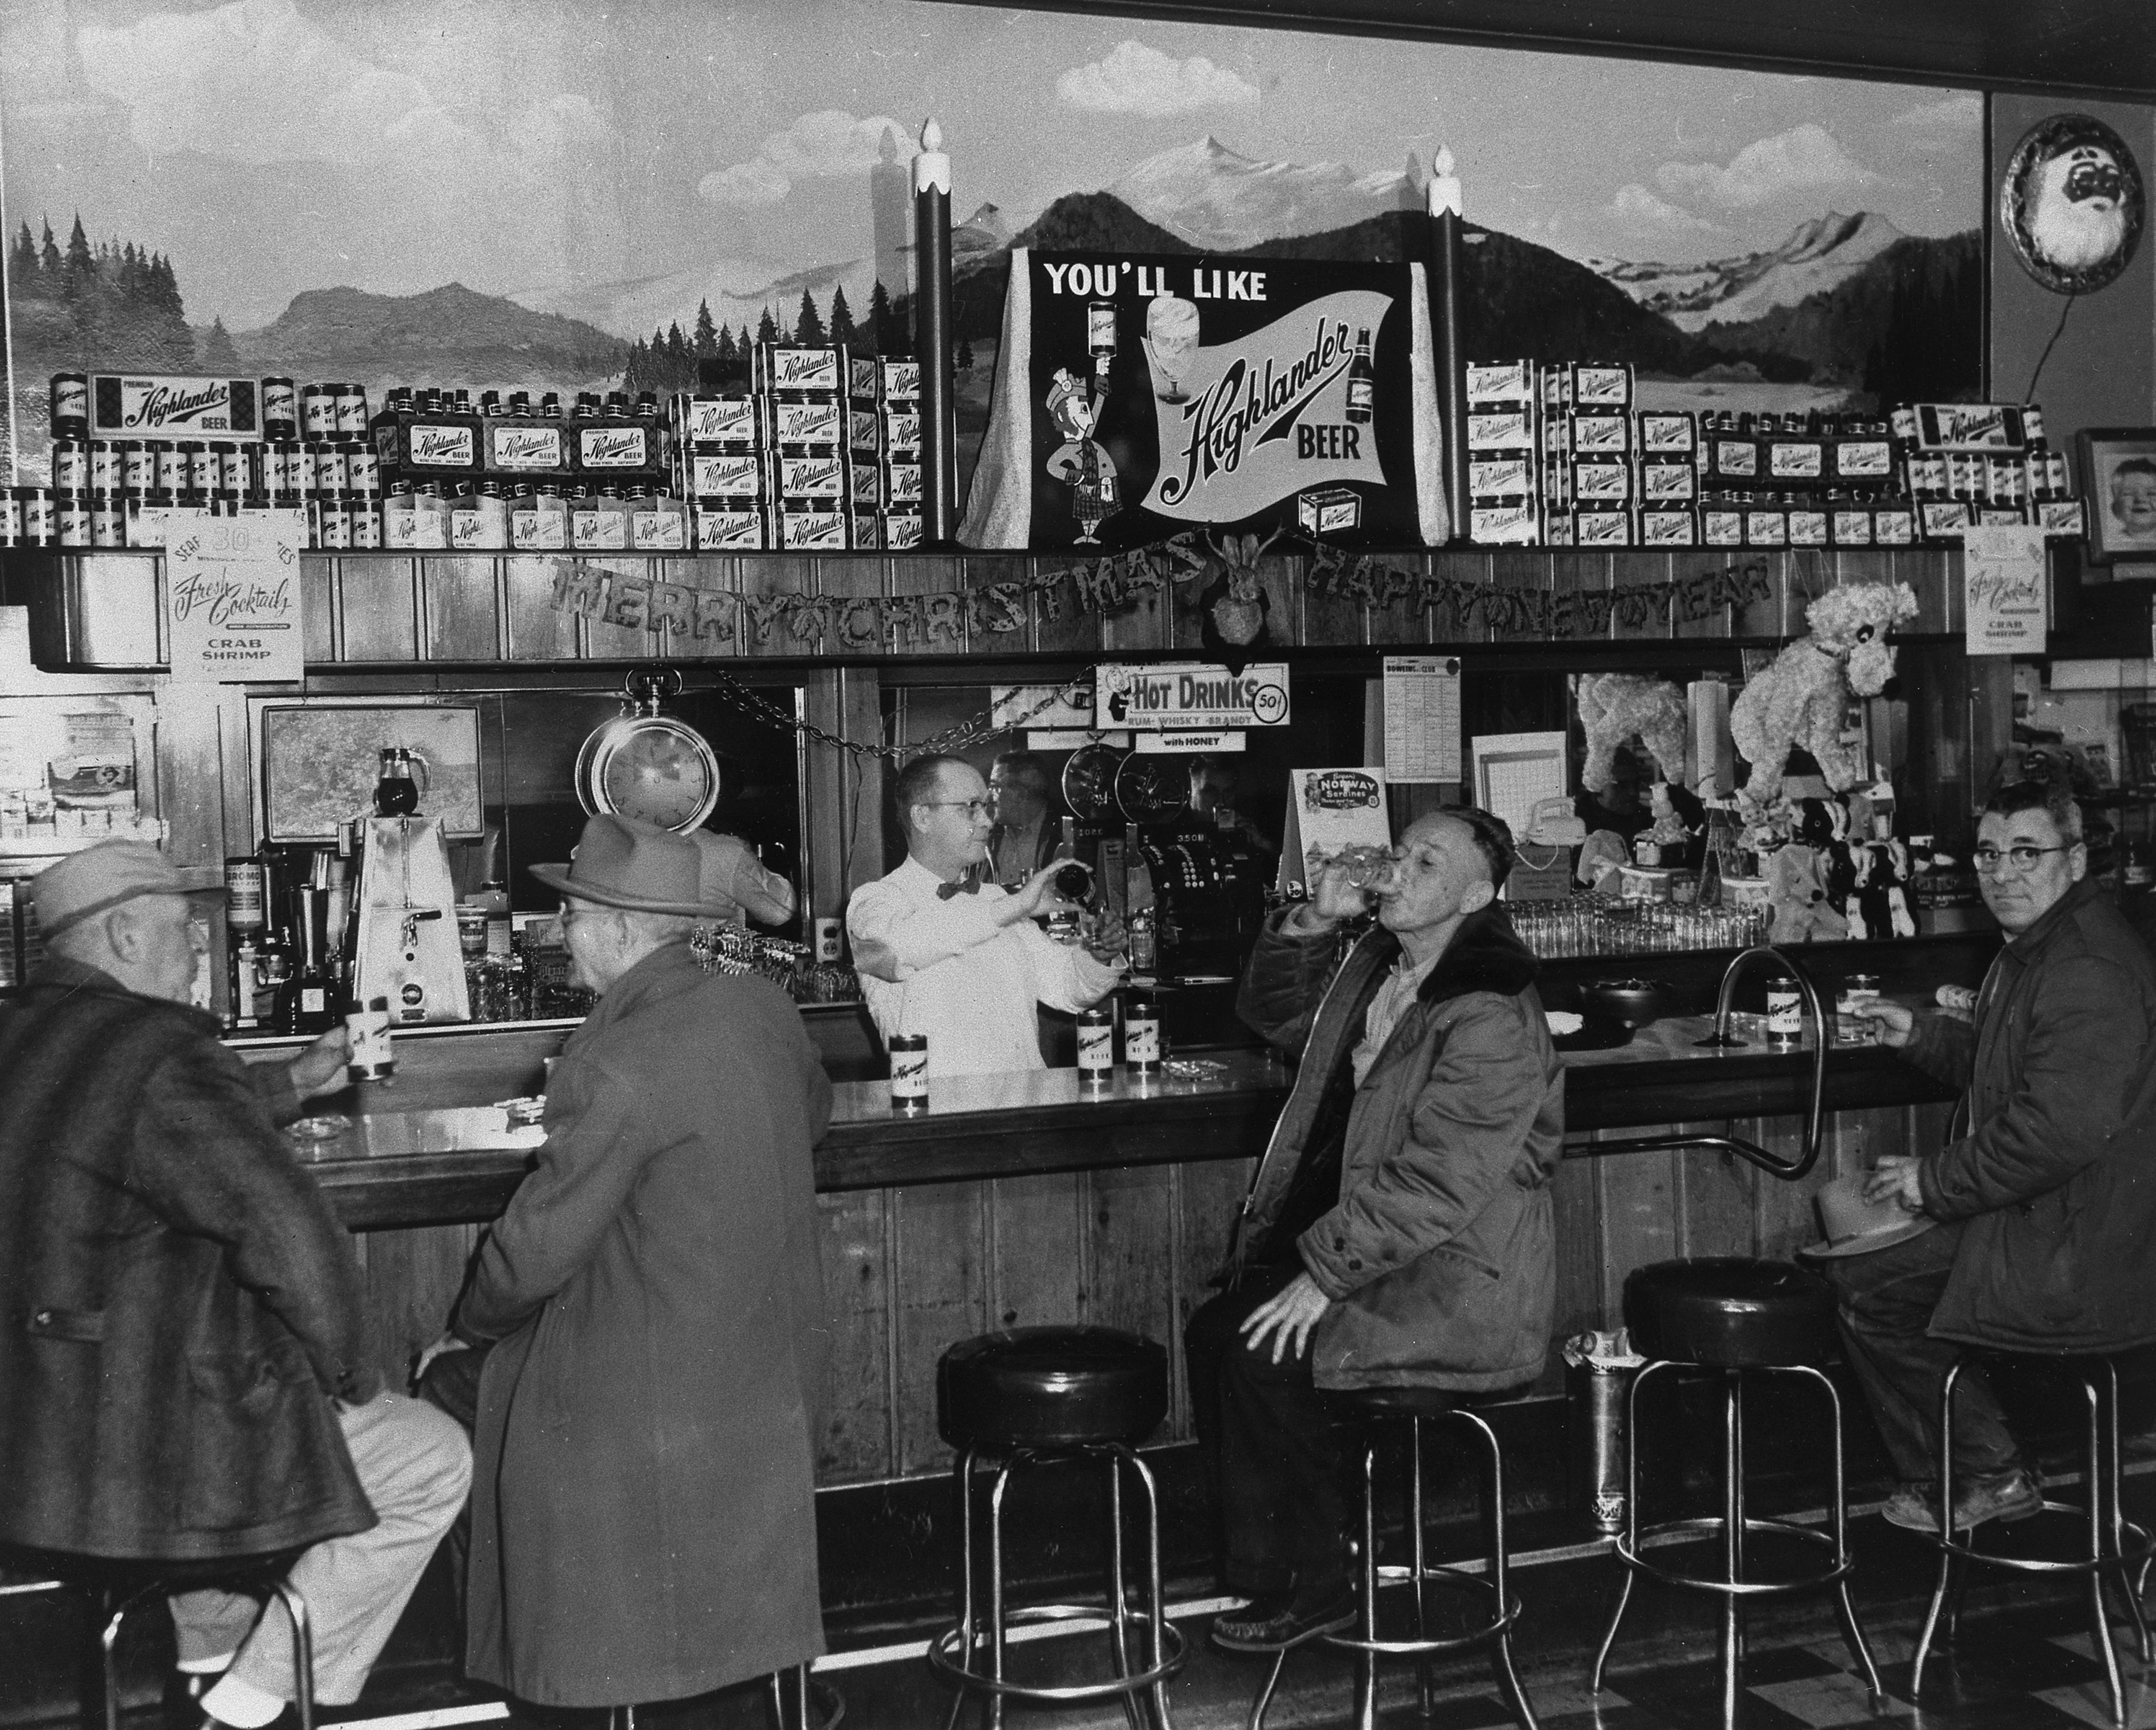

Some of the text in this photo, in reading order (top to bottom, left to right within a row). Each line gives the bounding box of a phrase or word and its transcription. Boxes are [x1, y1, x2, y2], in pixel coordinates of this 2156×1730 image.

[1043, 262, 1267, 301] YOU'LL LIKE
[125, 382, 229, 427] Highlander
[1160, 317, 1354, 505] Highlander
[202, 417, 228, 430] BEER
[413, 431, 468, 458] Highlander
[497, 433, 554, 459] Highlander
[584, 433, 641, 460] Highlander
[1297, 424, 1361, 460] BEER
[174, 567, 229, 621] Fresh
[209, 578, 292, 625] Cocktails
[551, 532, 1207, 647] MERRY CHRISTMAS
[1307, 542, 1481, 628] HAPPY
[1646, 556, 1771, 627] YEAR
[202, 651, 271, 660] SHRIMP
[208, 639, 262, 648] CRAB
[1185, 738, 1220, 746] HONEY
